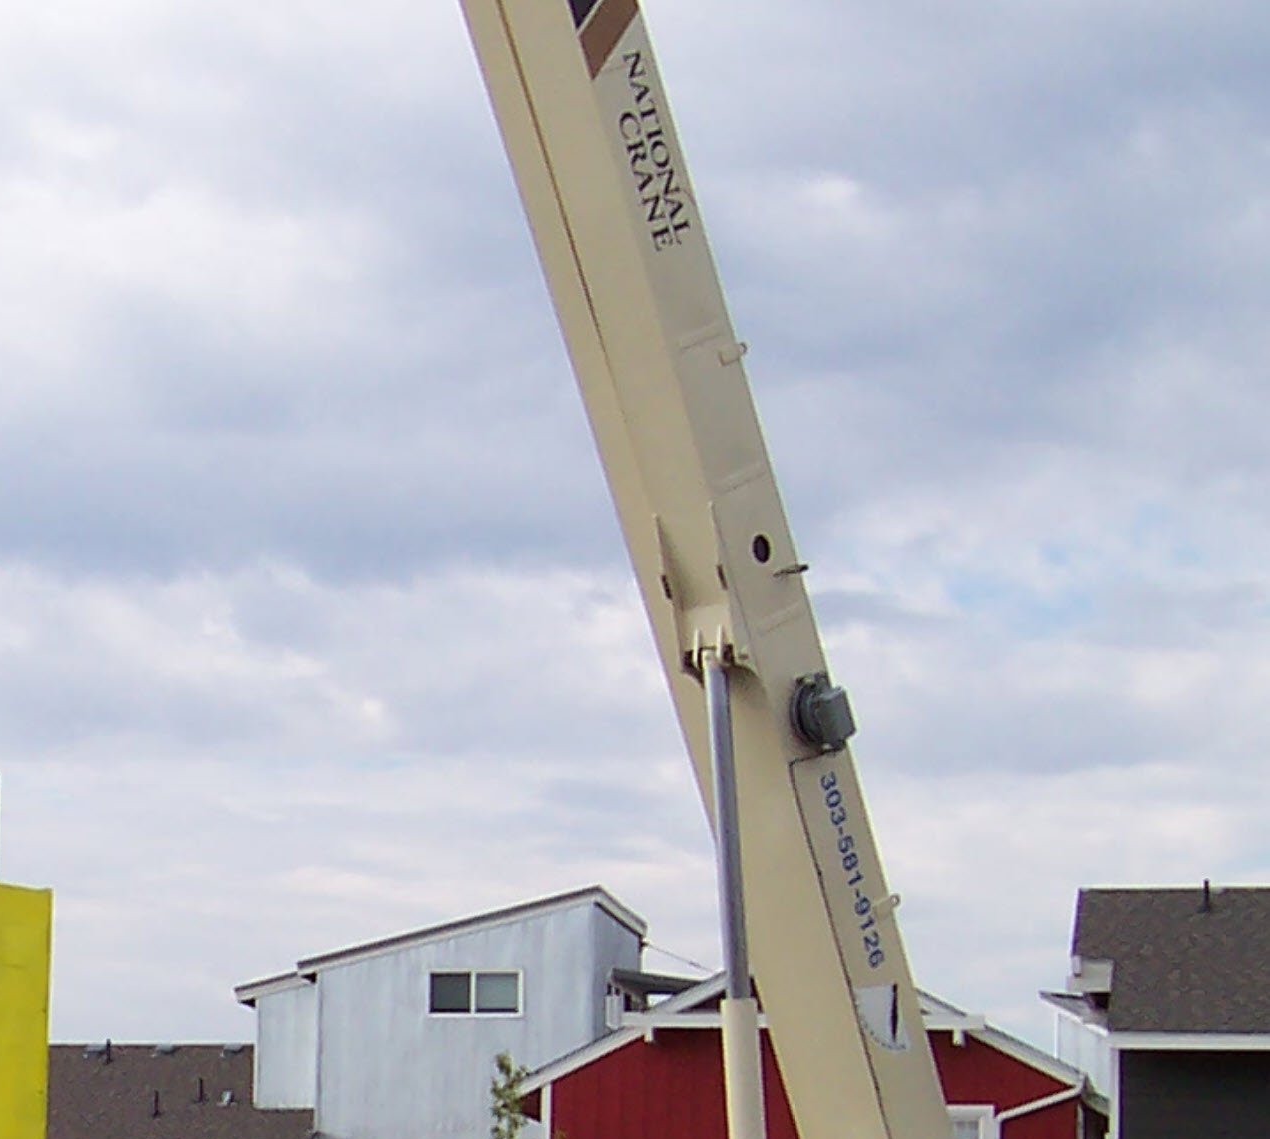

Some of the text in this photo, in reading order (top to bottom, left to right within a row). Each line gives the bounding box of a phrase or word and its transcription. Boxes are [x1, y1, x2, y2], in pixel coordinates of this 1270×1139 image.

[619, 111, 674, 252] CRANE
[622, 51, 691, 246] NATIONAL
[820, 770, 886, 970] 303-581-9126
